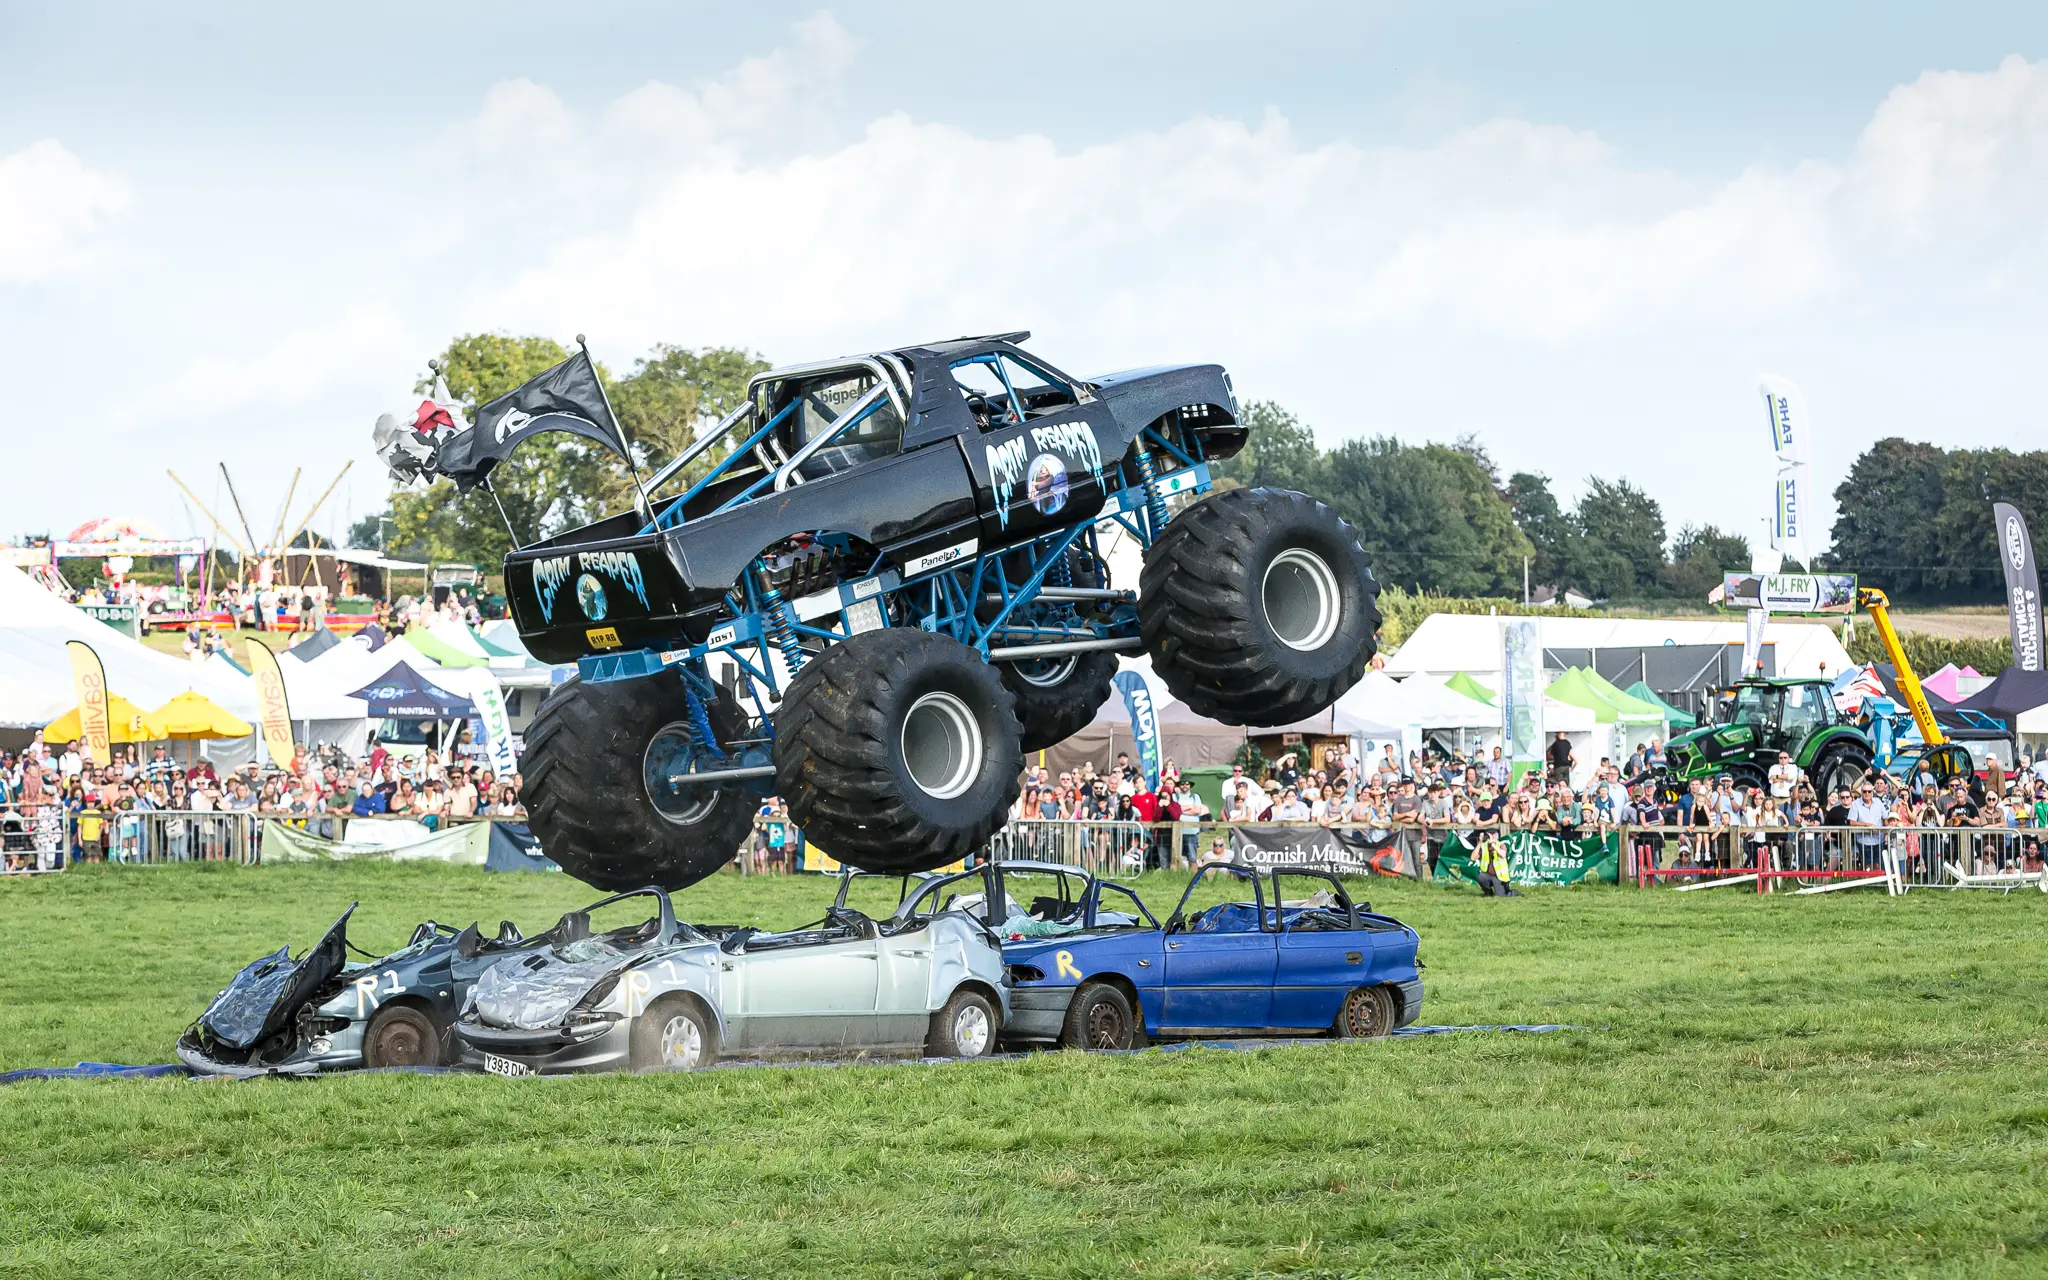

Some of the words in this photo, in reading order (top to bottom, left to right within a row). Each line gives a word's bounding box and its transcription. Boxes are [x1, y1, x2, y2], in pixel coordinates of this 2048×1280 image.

[985, 434, 1029, 531] GRIM
[1030, 421, 1107, 497] REAPER
[532, 555, 572, 624] GRIM
[578, 552, 651, 612] REAPER
[1790, 577, 1811, 593] FRY
[605, 633, 617, 642] RB
[709, 632, 733, 646] JOST
[388, 706, 398, 715] IN
[398, 706, 436, 716] PAINTBALL
[1241, 843, 1307, 864] Cornish
[1333, 863, 1369, 876] Experts
[1515, 855, 1584, 869] BUTCHERS
[1528, 869, 1563, 880] DORSET
[1055, 950, 1083, 980] R
[486, 1054, 510, 1075] Y393
[511, 1063, 529, 1076] DW
